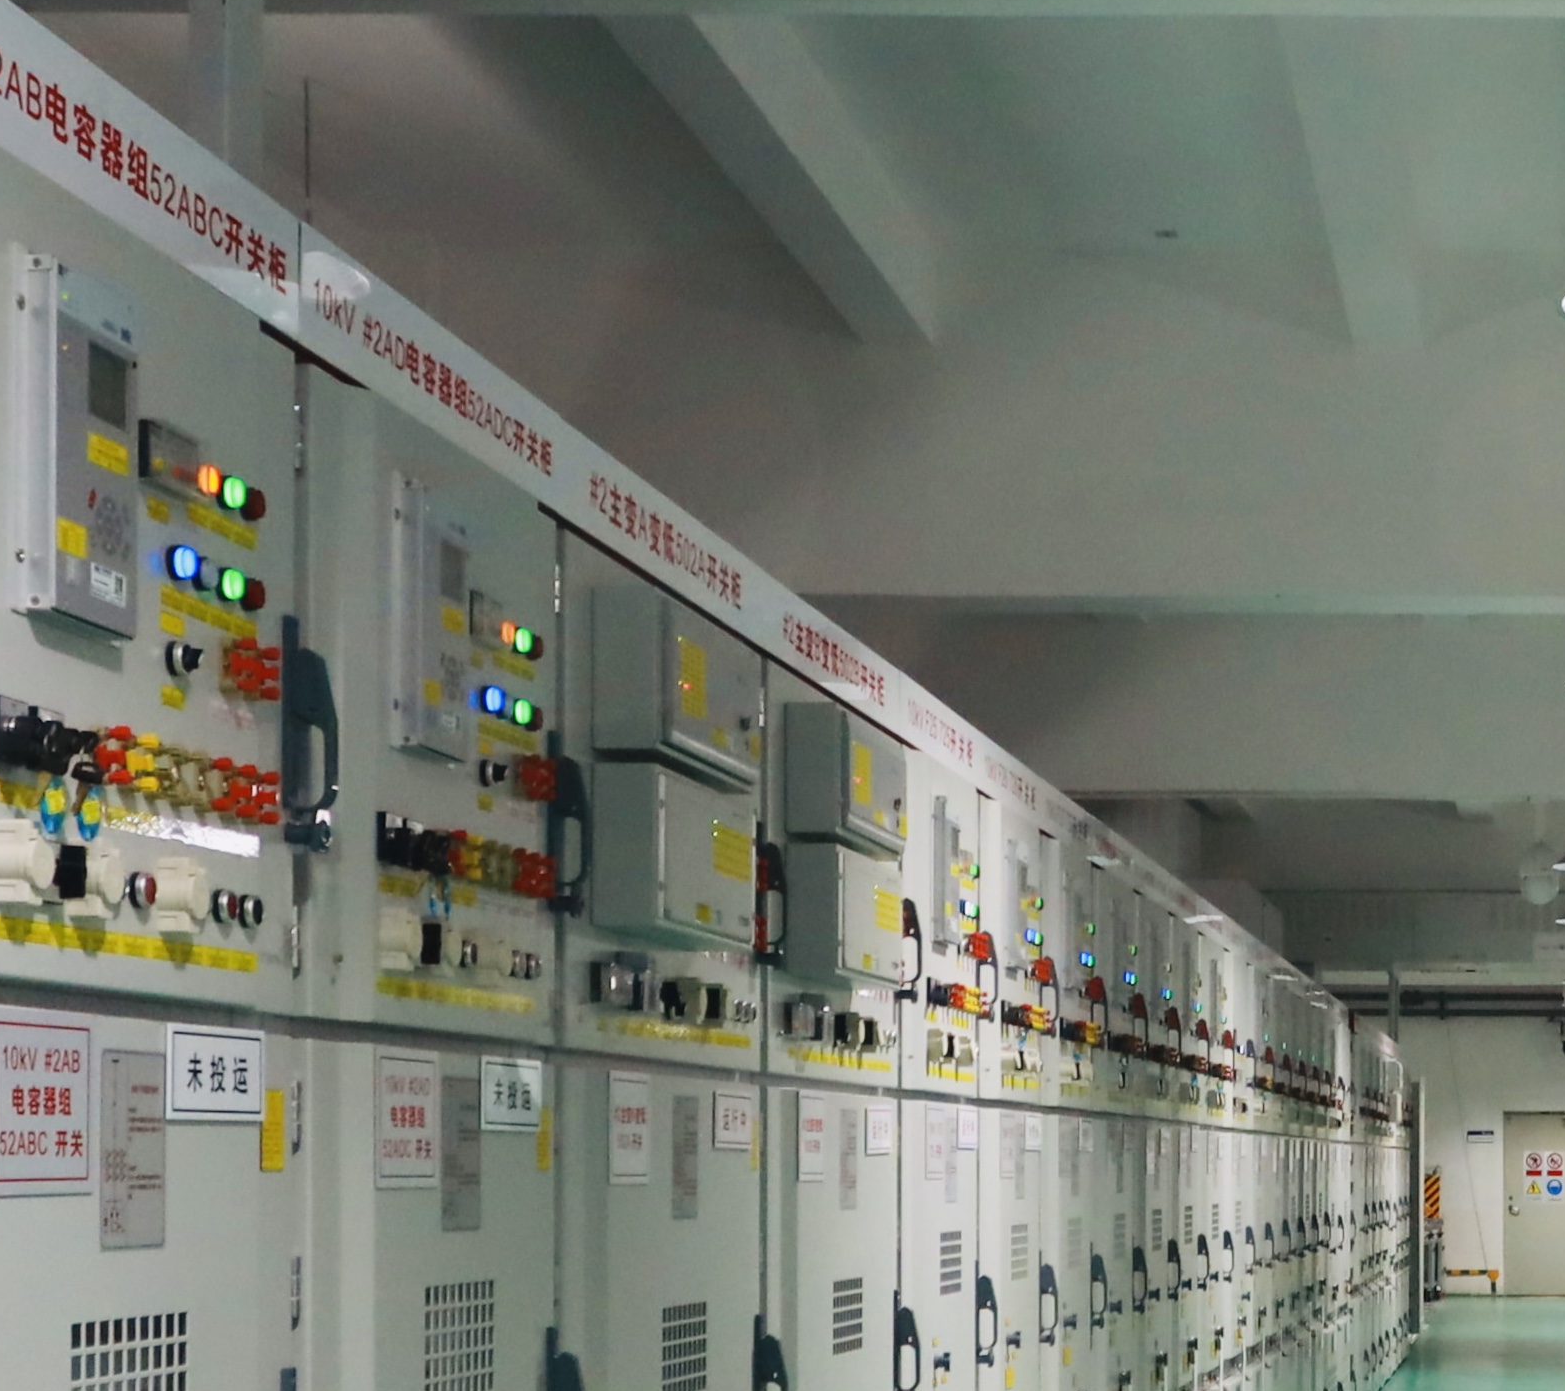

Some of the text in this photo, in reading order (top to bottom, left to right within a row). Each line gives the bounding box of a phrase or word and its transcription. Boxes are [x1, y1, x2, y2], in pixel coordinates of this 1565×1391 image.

[314, 278, 356, 335] 10kV
[3, 1046, 81, 1073] 10kV #2AB
[187, 1053, 248, 1094] 未投运
[12, 1084, 72, 1116] 电容器组
[0, 1130, 83, 1158] 52ABC 开关
